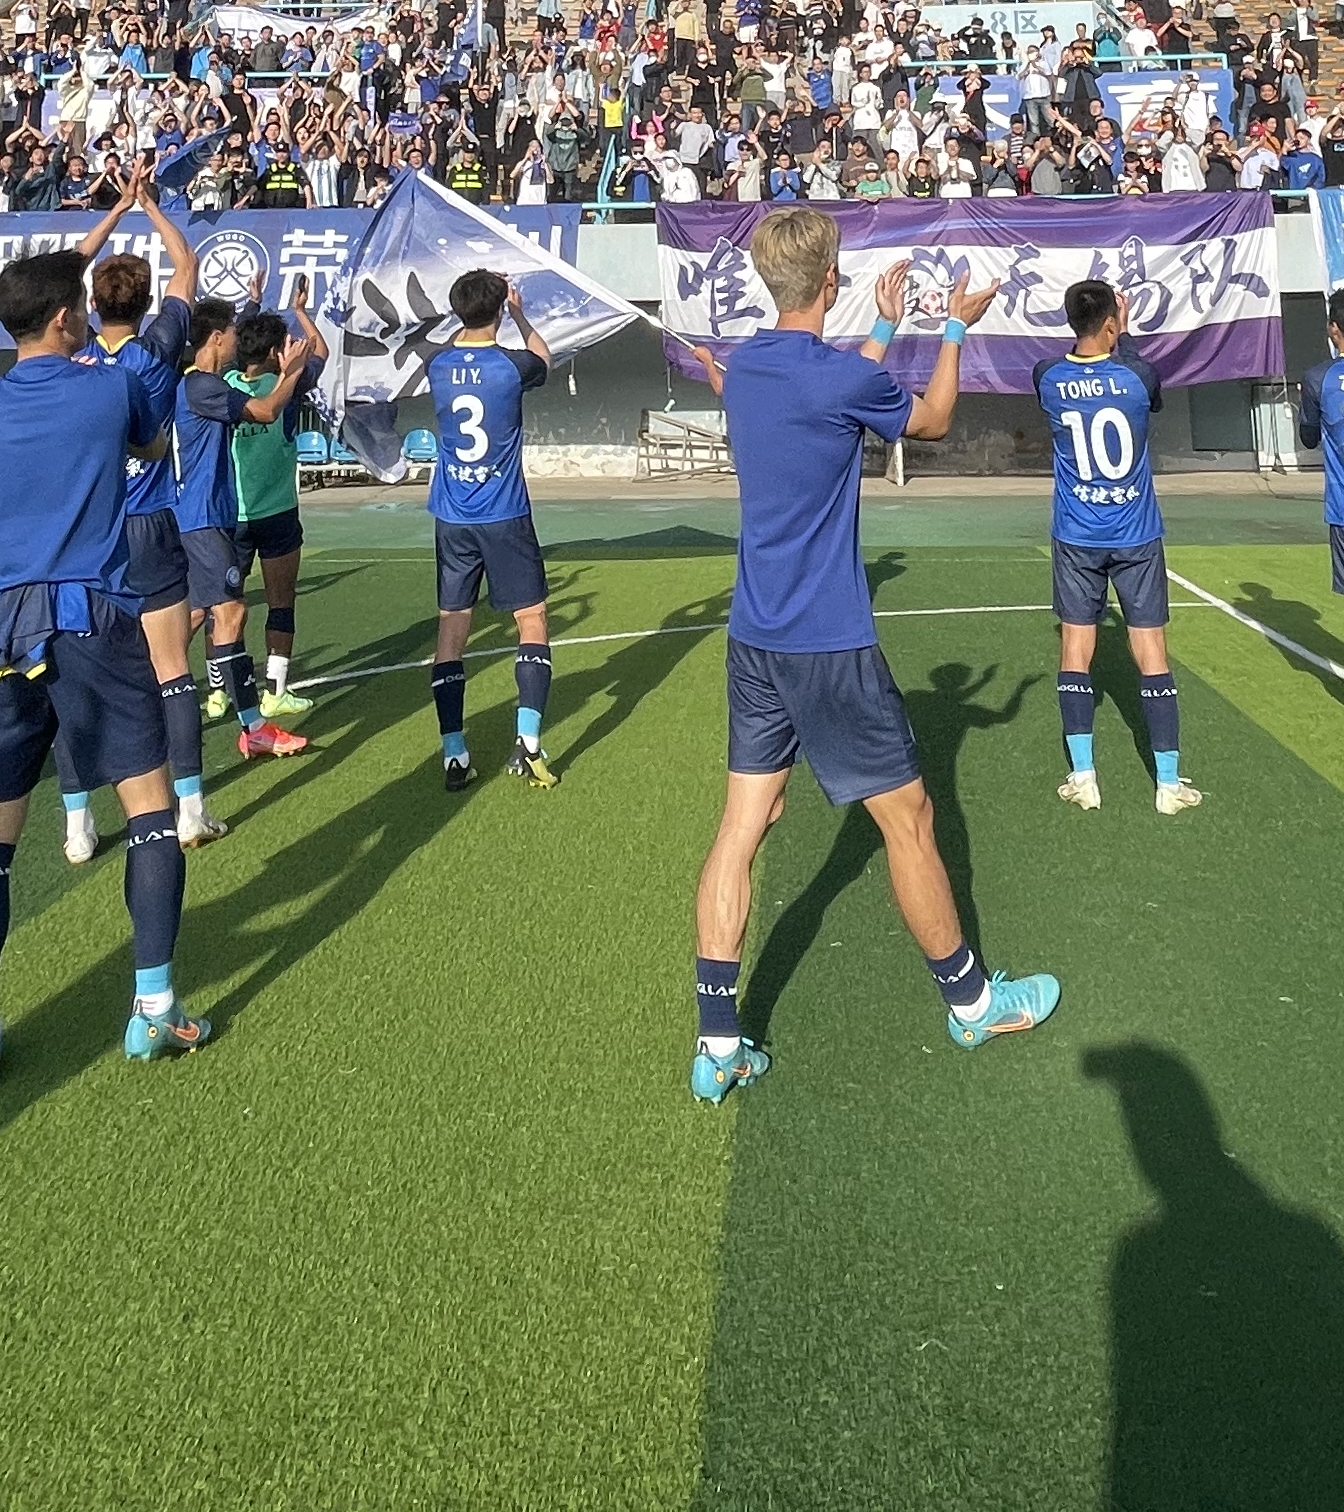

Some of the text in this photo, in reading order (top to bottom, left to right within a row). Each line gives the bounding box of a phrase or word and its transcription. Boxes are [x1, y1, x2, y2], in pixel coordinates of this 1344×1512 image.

[968, 9, 1041, 35] 8区
[451, 368, 482, 385] LI Y.
[1056, 377, 1128, 400] TONG L.
[451, 394, 489, 463] 3
[1060, 407, 1134, 481] 10
